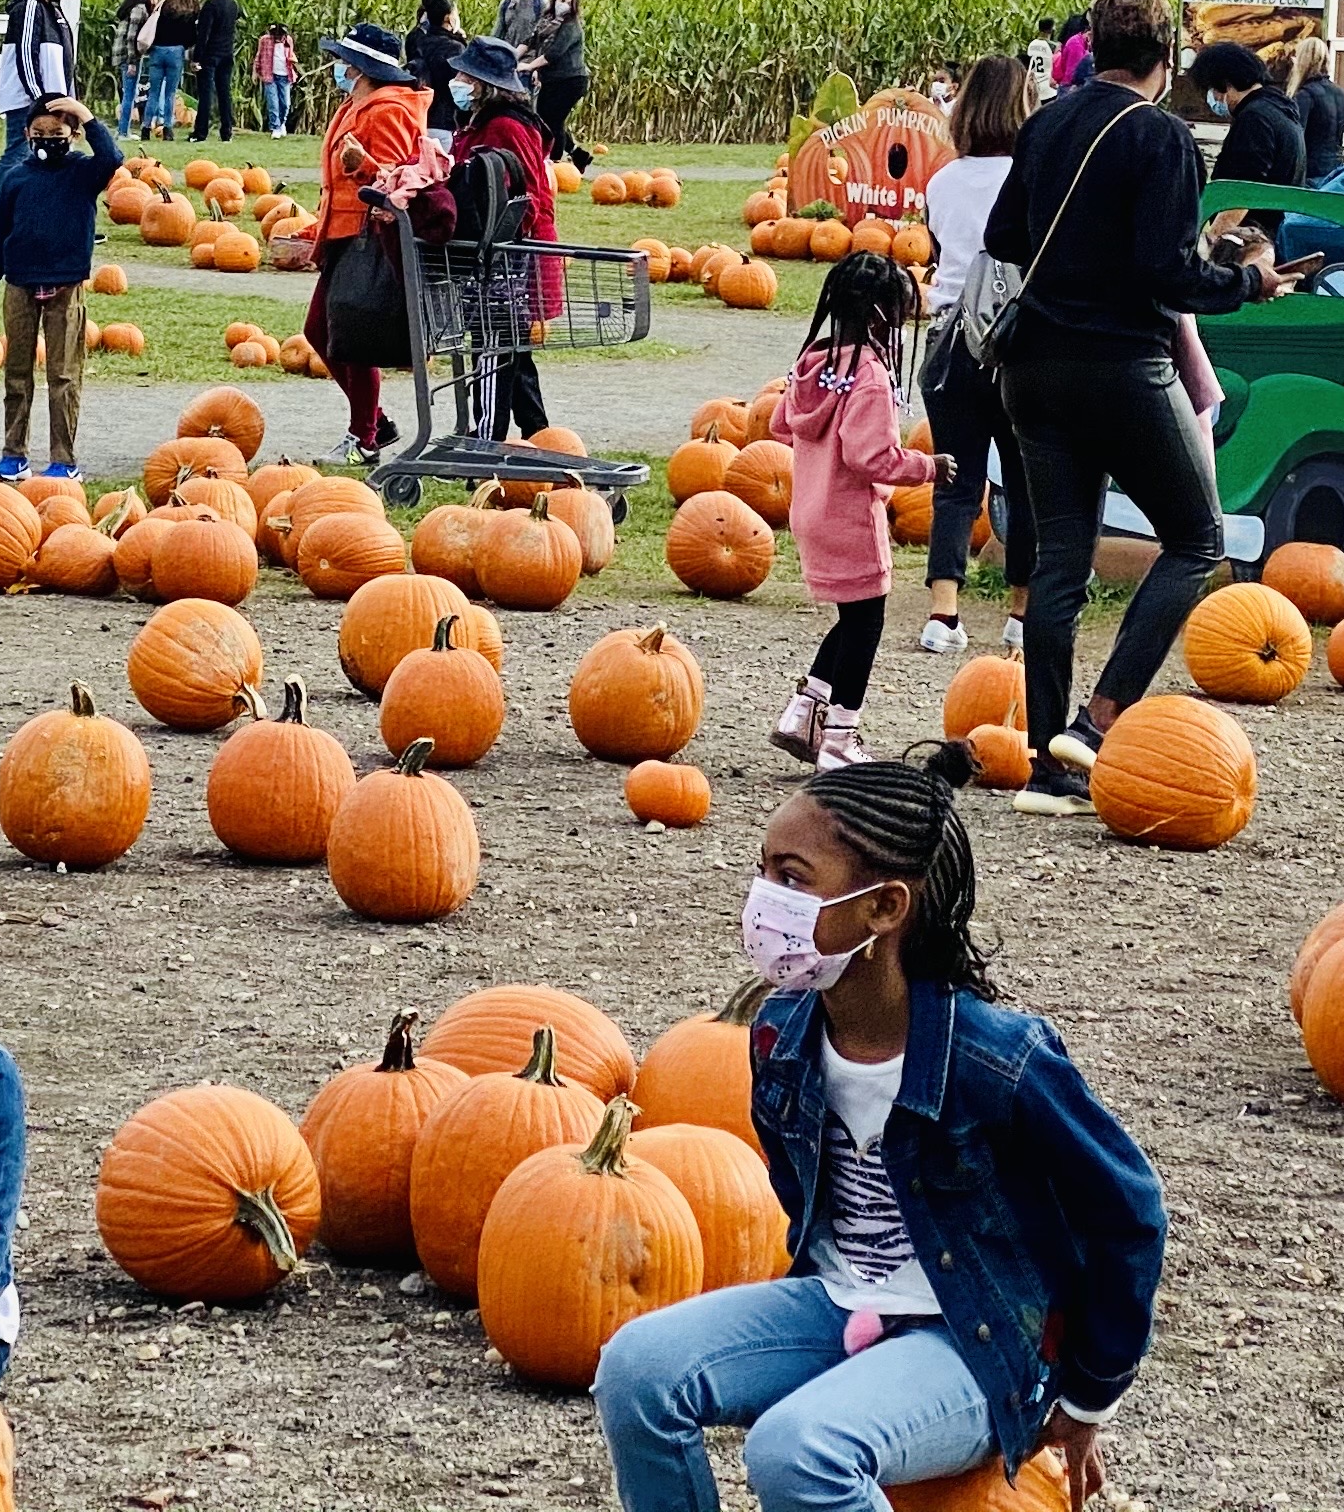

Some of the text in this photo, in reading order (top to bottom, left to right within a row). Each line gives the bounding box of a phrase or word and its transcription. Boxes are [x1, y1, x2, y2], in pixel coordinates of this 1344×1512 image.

[819, 107, 949, 149] PICKIN' PUMPKIN
[845, 181, 925, 210] White Po
